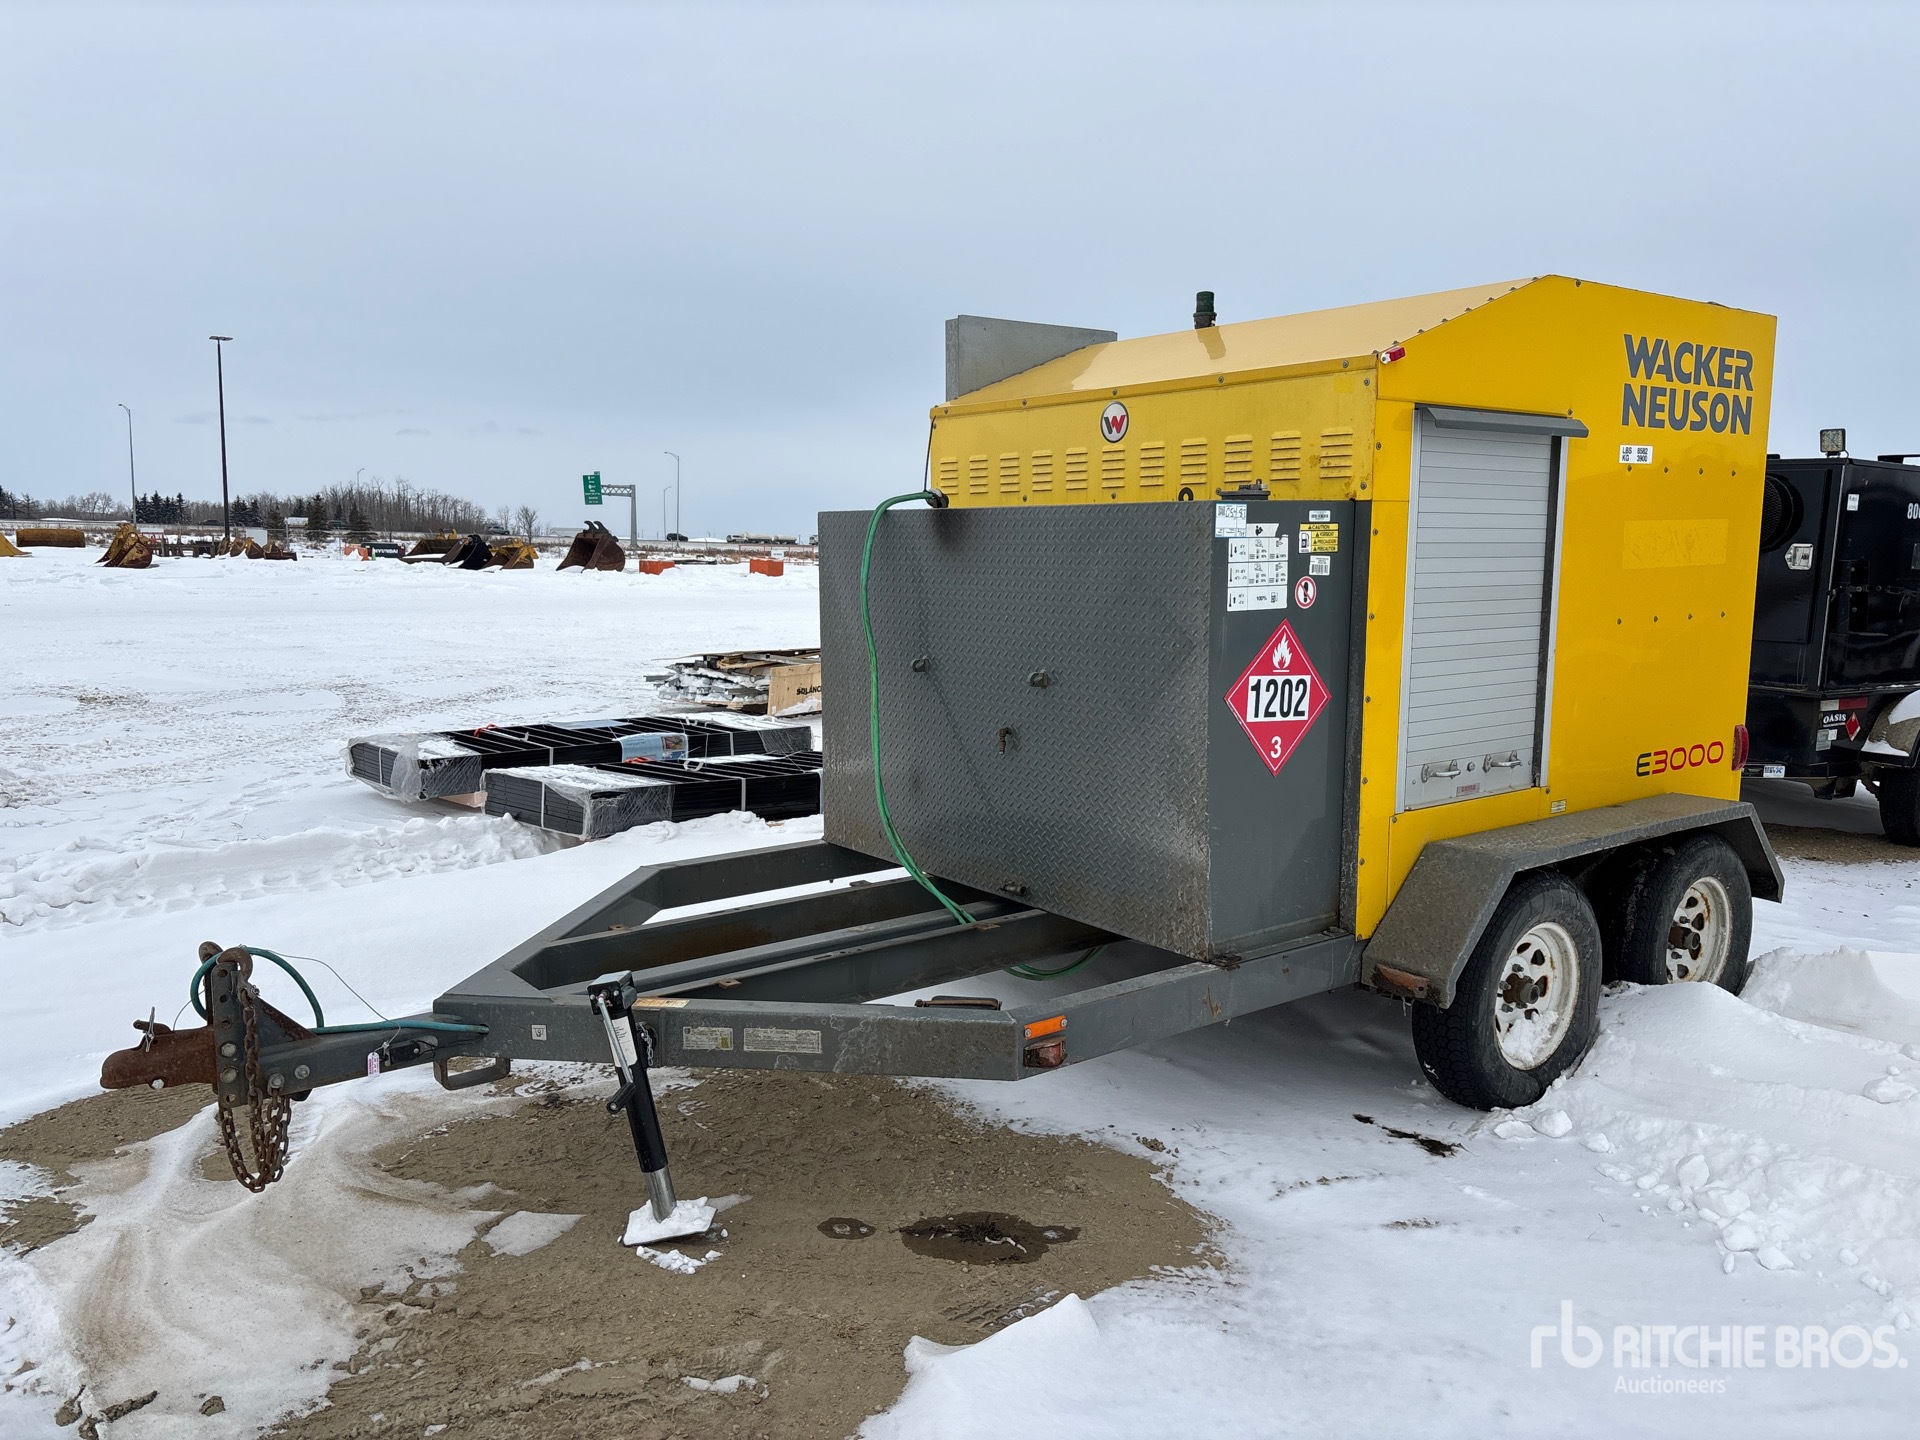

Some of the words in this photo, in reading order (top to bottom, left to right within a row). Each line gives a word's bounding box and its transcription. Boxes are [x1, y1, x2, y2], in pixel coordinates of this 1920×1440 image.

[1624, 334, 1754, 392] WACKER
[1104, 415, 1126, 434] W
[1622, 383, 1753, 435] NEUSON
[1250, 678, 1308, 718] 1202
[1823, 713, 1847, 724] OASIS
[1270, 736, 1282, 759] 3
[1636, 741, 1724, 777] E3000
